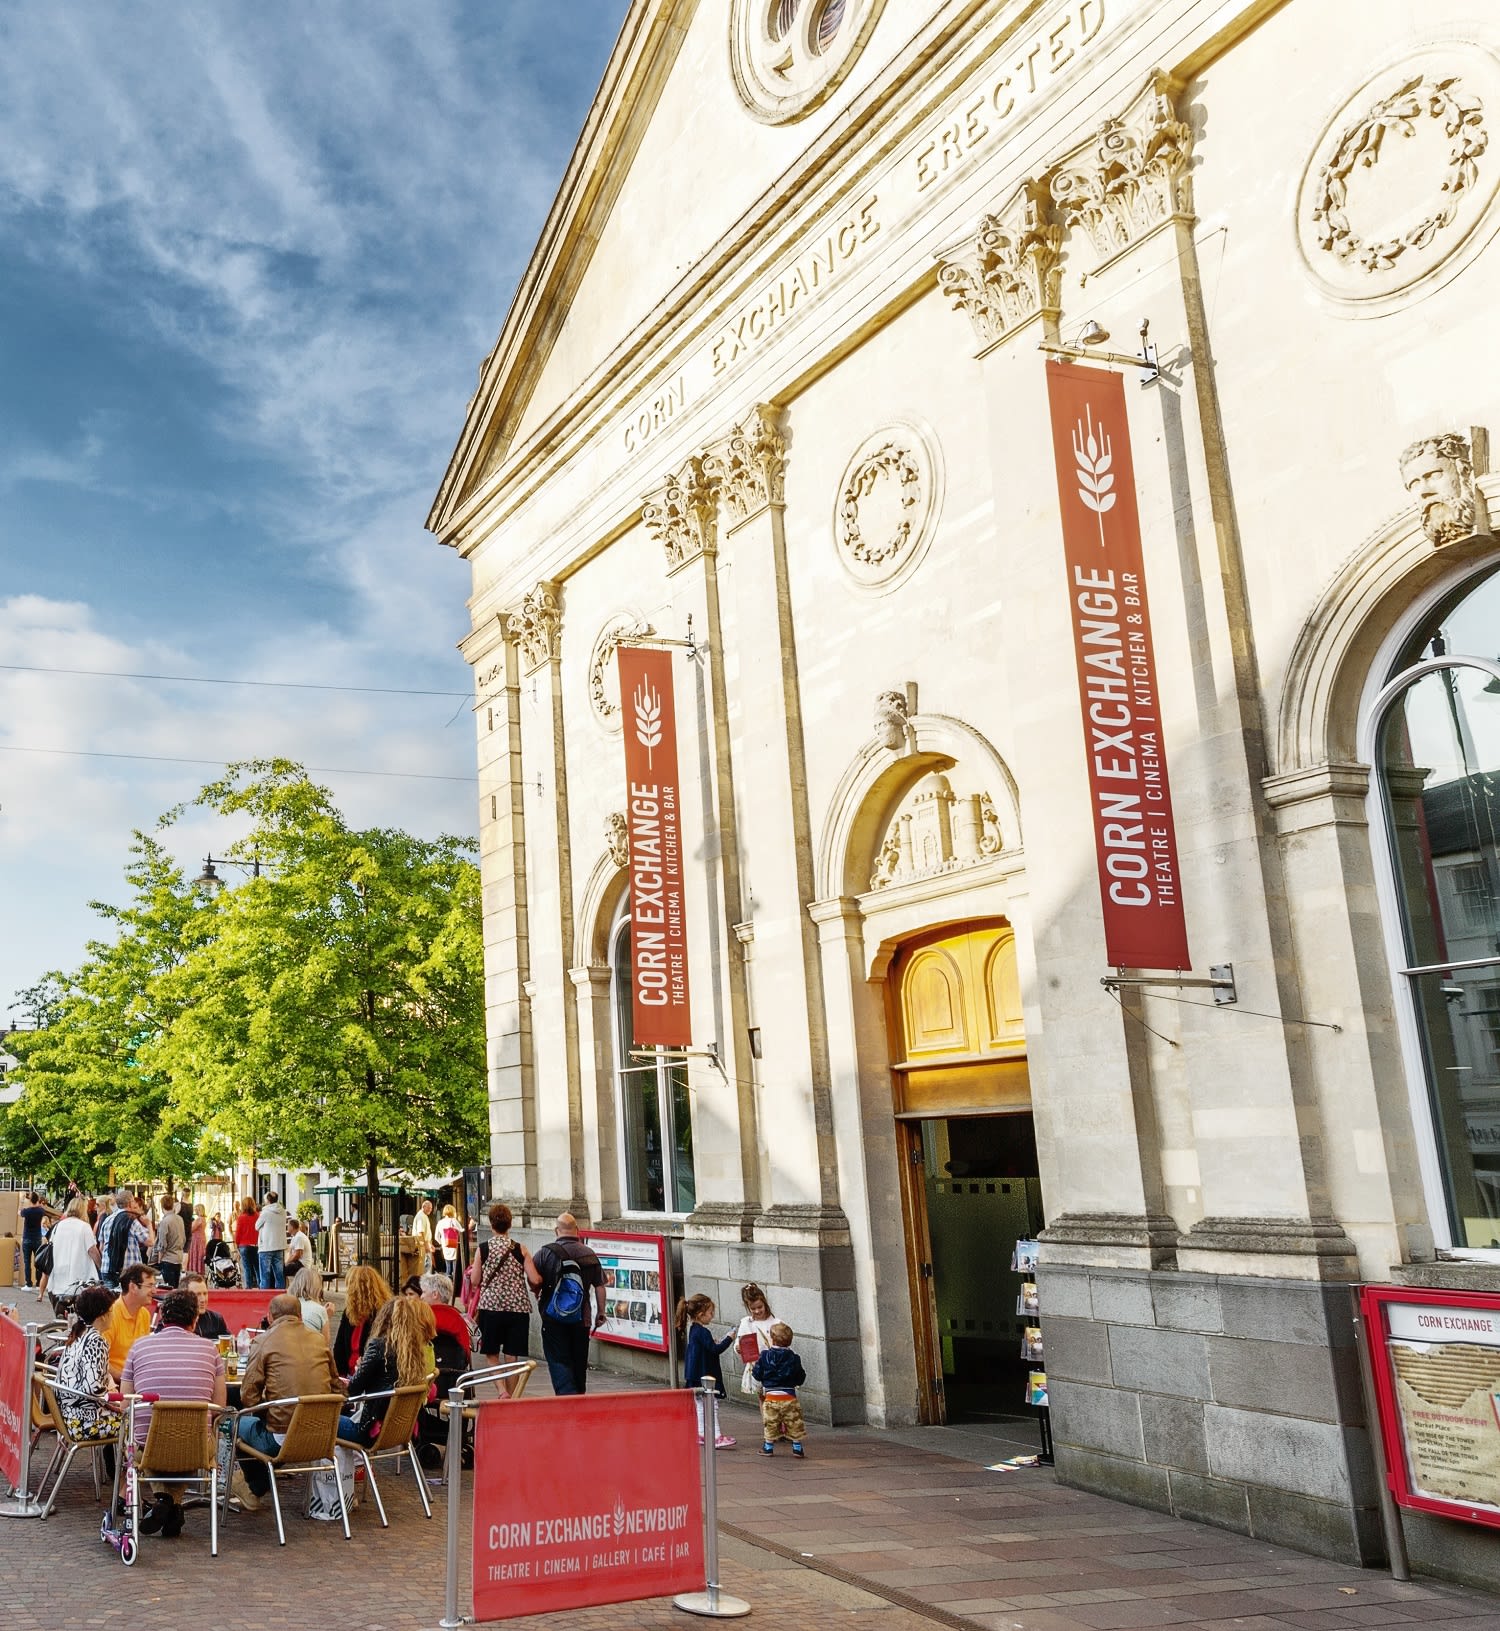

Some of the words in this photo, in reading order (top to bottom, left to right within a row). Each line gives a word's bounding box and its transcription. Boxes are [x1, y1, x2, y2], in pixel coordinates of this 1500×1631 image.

[624, 376, 685, 453] CORN
[917, 0, 1105, 192] ERECTED
[1123, 572, 1140, 607] BAR
[1126, 613, 1143, 625] &
[1074, 564, 1139, 780] EXCHANGE
[1129, 631, 1153, 706] KITCHEN
[1138, 732, 1162, 800] CINEMA
[663, 786, 674, 809] BAR
[664, 812, 676, 822] &
[631, 782, 665, 924] EXCHANGE
[665, 825, 678, 874] KITCHEN
[1099, 792, 1152, 907] CORN
[1151, 827, 1175, 907] THEATRE
[668, 895, 681, 937] CINEMA
[636, 931, 668, 1006] CORN
[671, 953, 685, 1006] THEATRE
[1417, 1315, 1442, 1329] CORN
[1443, 1317, 1493, 1332] EXCHANGE
[488, 1522, 531, 1549] CORN
[535, 1514, 611, 1545] EXCHANGE
[626, 1504, 689, 1535] NEWBURY
[488, 1562, 531, 1581] THEATRE
[544, 1557, 580, 1575] CINEMA
[592, 1549, 630, 1569] GALLERY
[642, 1543, 666, 1562] CAFÉ
[675, 1542, 690, 1558] BAR
